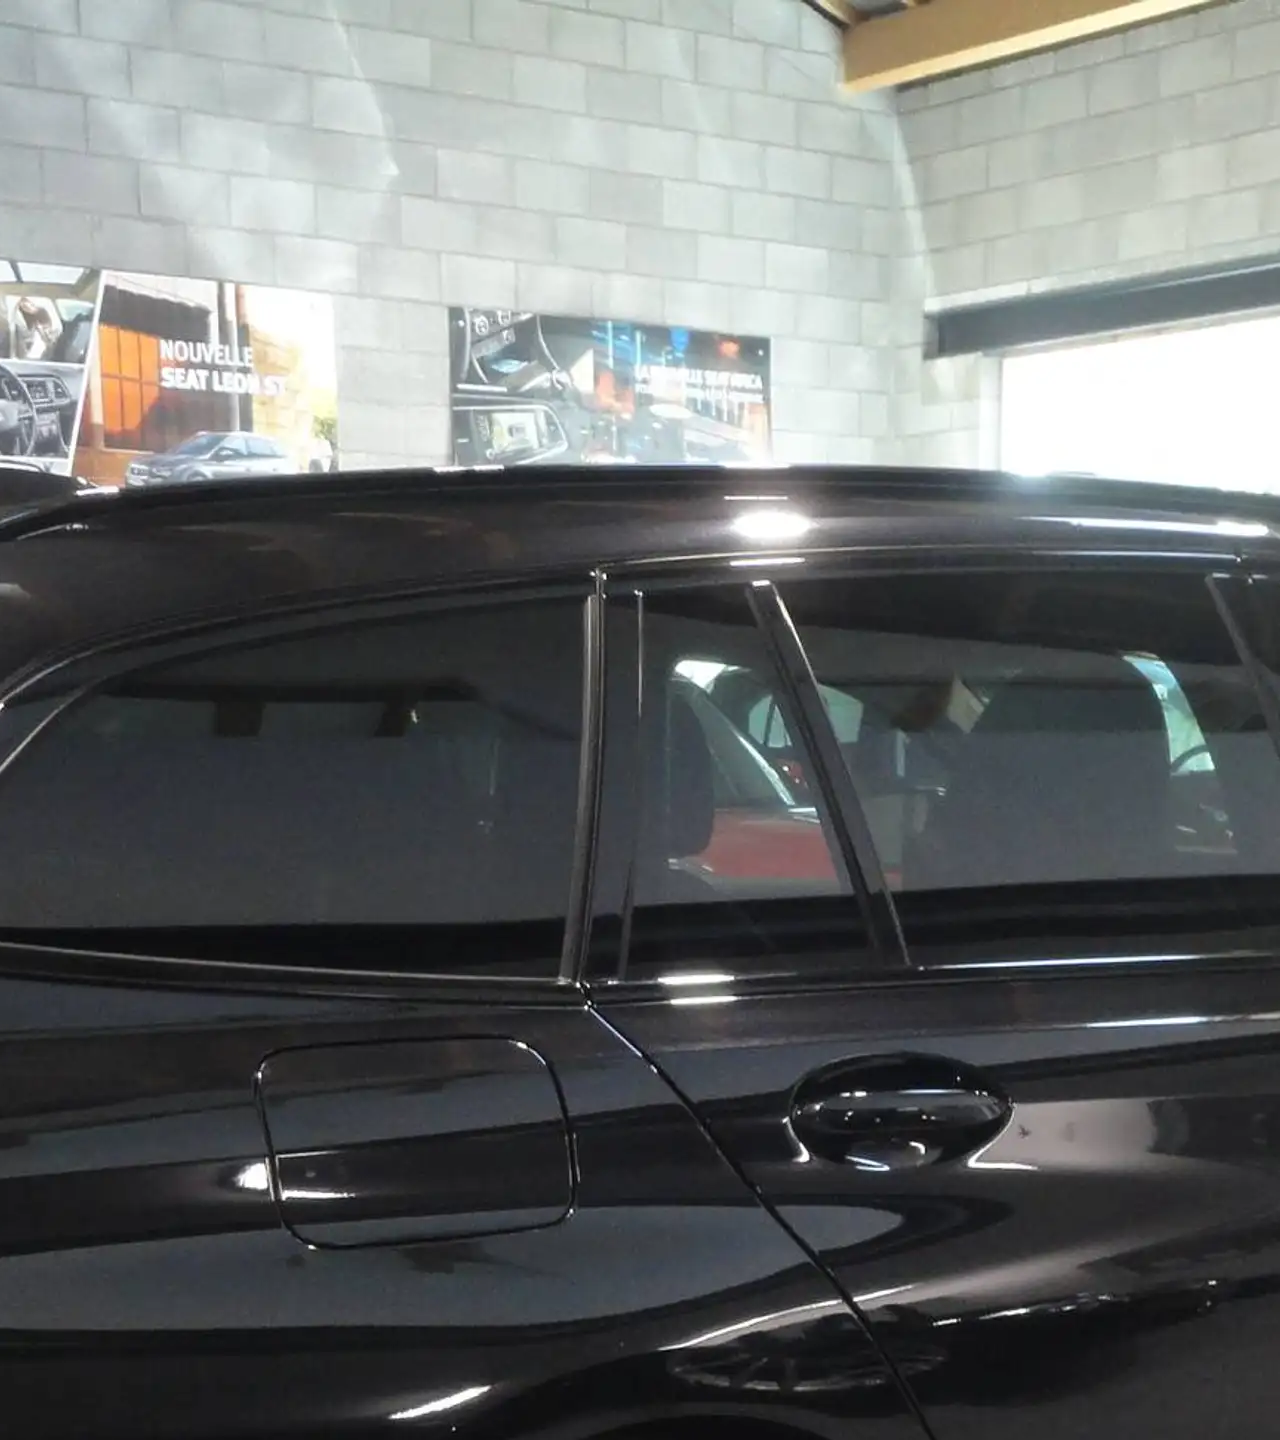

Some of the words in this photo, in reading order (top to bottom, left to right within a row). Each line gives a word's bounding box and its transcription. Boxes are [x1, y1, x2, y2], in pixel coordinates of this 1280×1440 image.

[160, 339, 254, 367] NOUVELLE
[160, 367, 210, 391] SEAT
[212, 369, 261, 395] LEON
